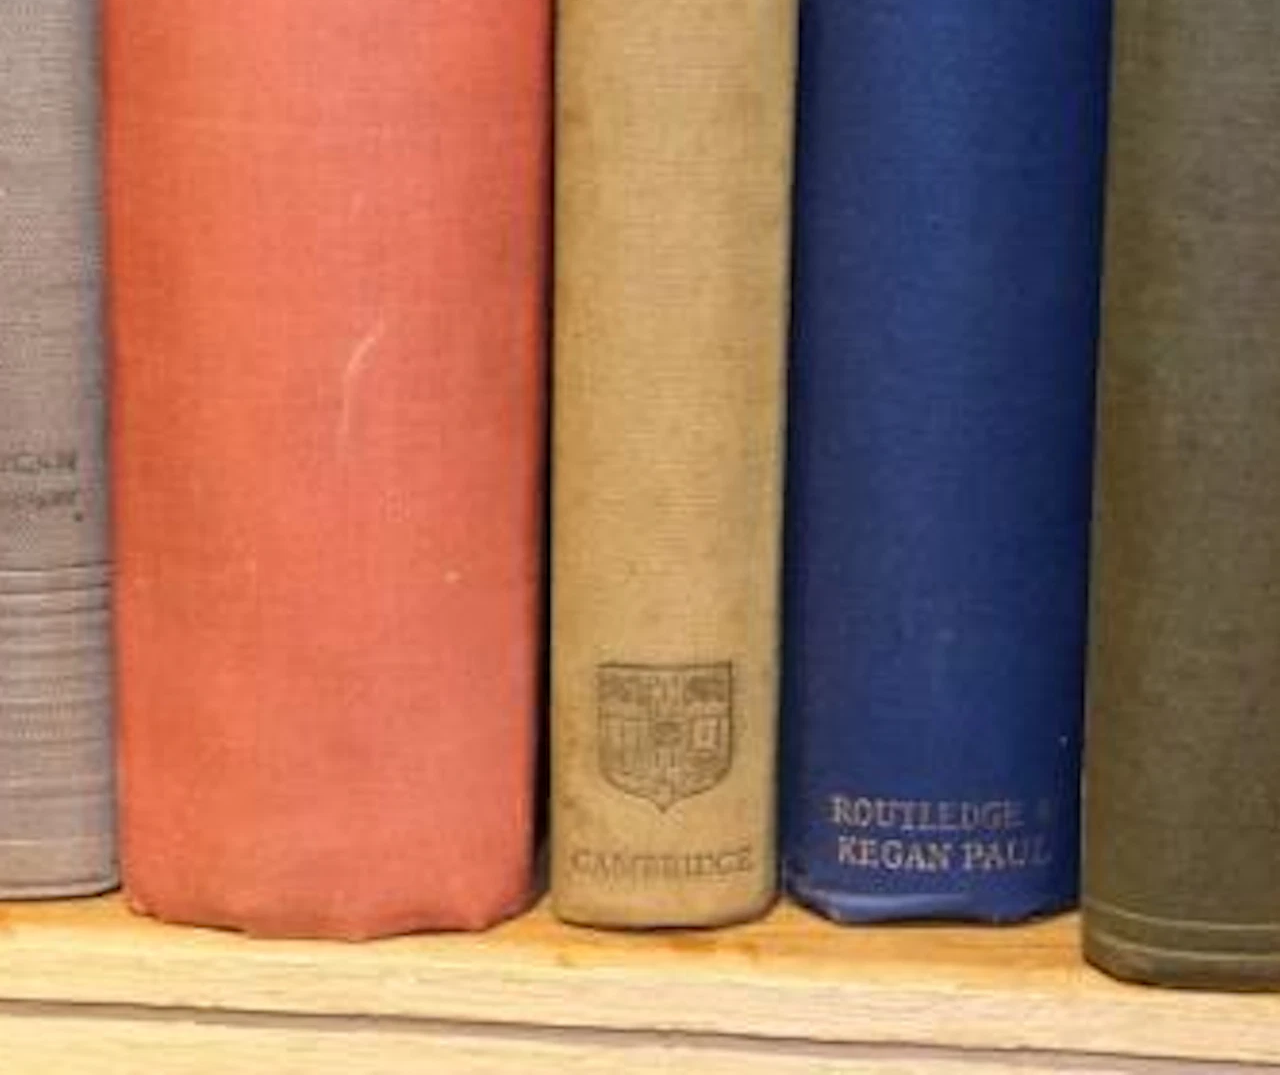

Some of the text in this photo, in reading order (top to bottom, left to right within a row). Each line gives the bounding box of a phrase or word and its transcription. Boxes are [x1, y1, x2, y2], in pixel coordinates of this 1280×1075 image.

[829, 795, 1025, 831] ROUTLEDGE
[837, 834, 1053, 872] KEGAN PAUL
